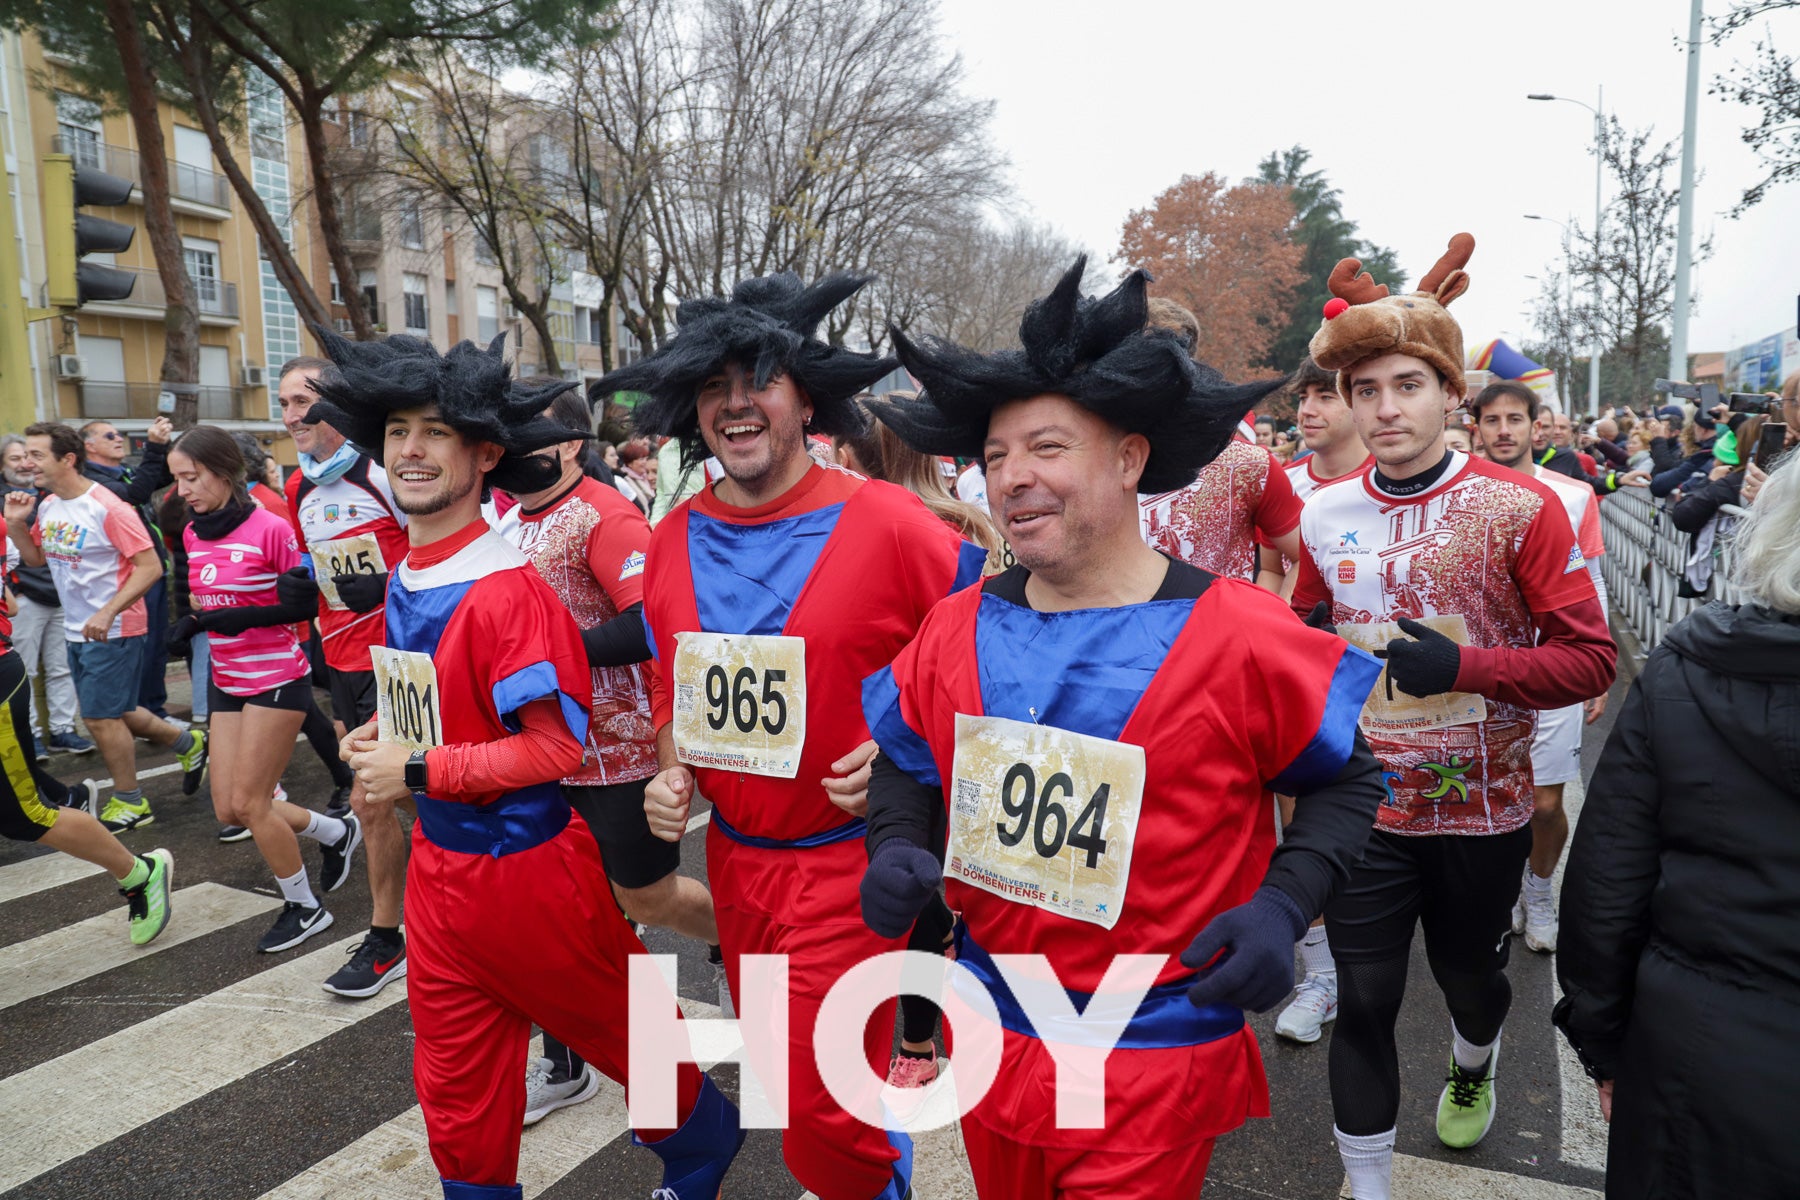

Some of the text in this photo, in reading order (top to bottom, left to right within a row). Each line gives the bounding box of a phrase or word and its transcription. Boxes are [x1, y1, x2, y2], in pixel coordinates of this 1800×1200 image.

[1338, 572, 1356, 580] KING
[197, 594, 237, 607] URICH
[706, 665, 787, 736] 965
[387, 676, 437, 747] 1001
[1372, 719, 1432, 730] DOMBENITENSE
[687, 753, 749, 768] DOMBENITENSE
[715, 752, 745, 760] SILVESTRE
[996, 762, 1111, 870] 964
[963, 867, 1046, 903] DOMBENITENSE
[967, 863, 1040, 891] XXIV SAN SILVESTRE
